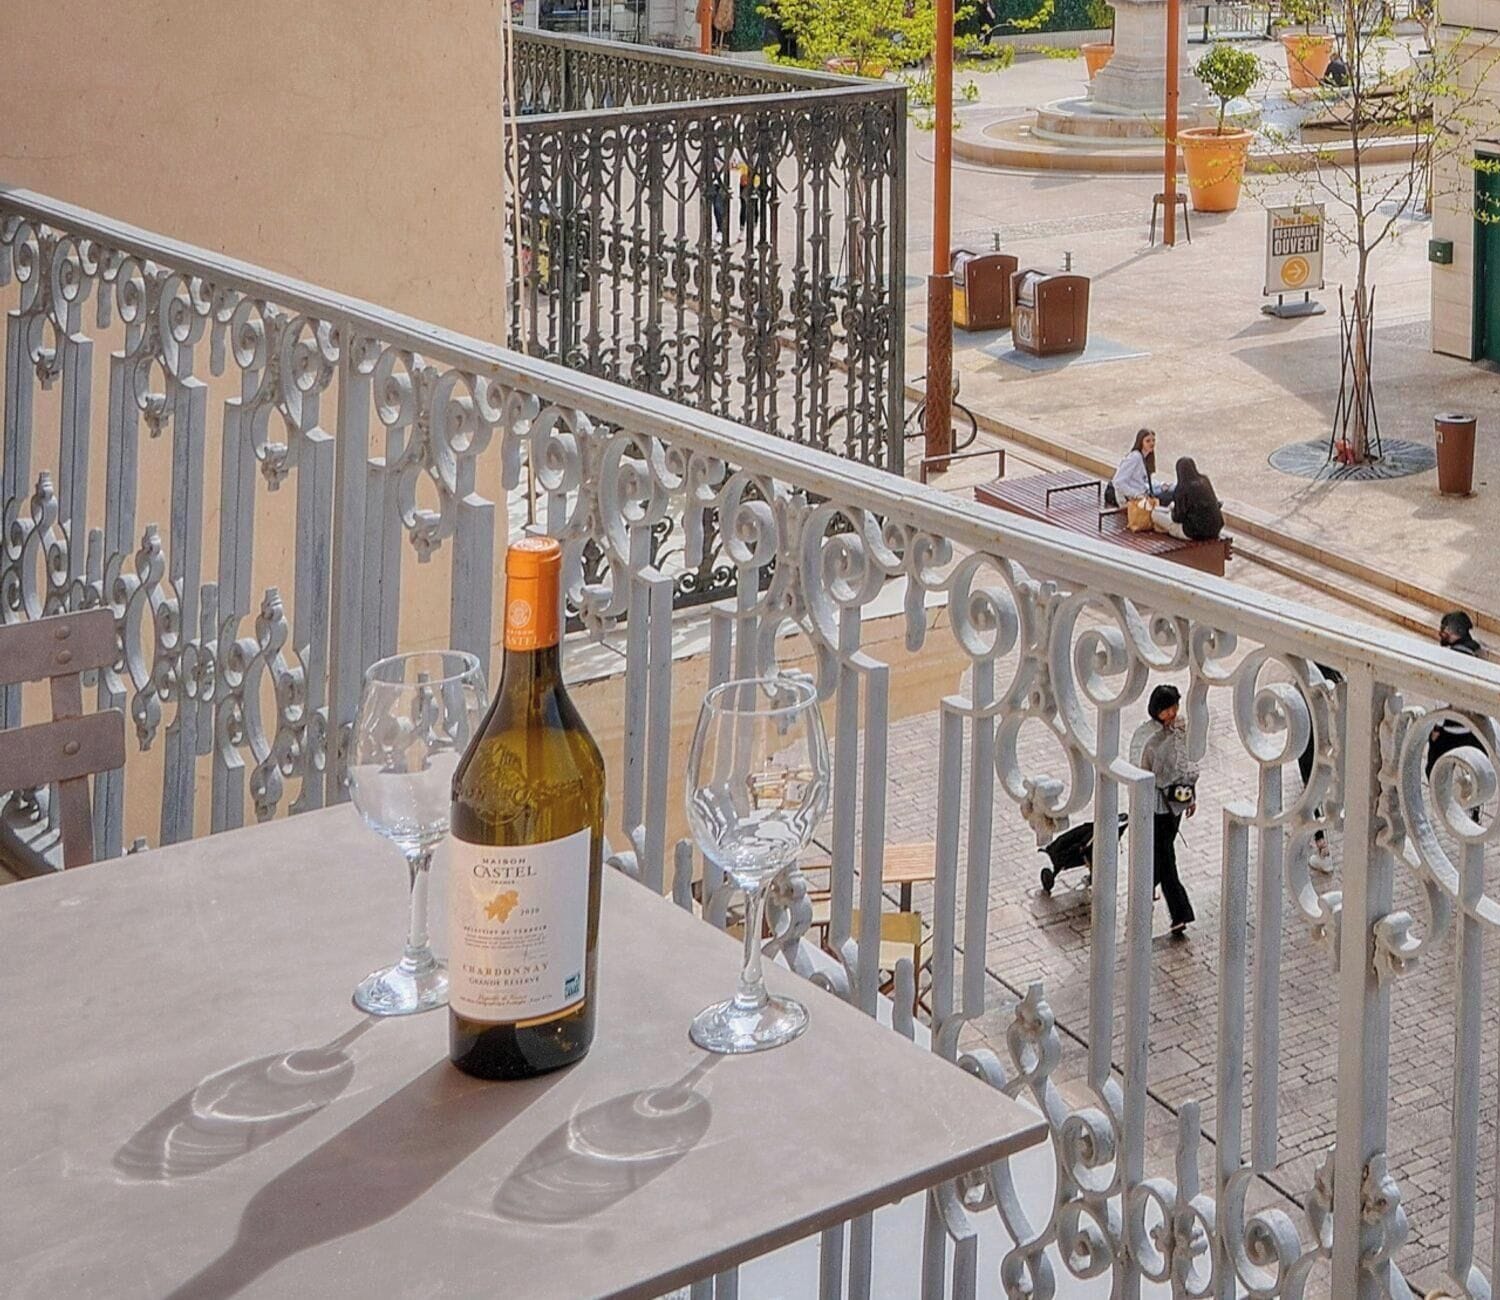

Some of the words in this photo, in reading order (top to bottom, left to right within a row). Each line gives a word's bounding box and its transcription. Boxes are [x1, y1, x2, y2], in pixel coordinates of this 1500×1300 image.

[1274, 226, 1318, 239] RESTAURANT
[1274, 237, 1318, 254] OUVERT
[473, 864, 537, 879] CASTEL
[462, 962, 549, 976] CHARDONNAY
